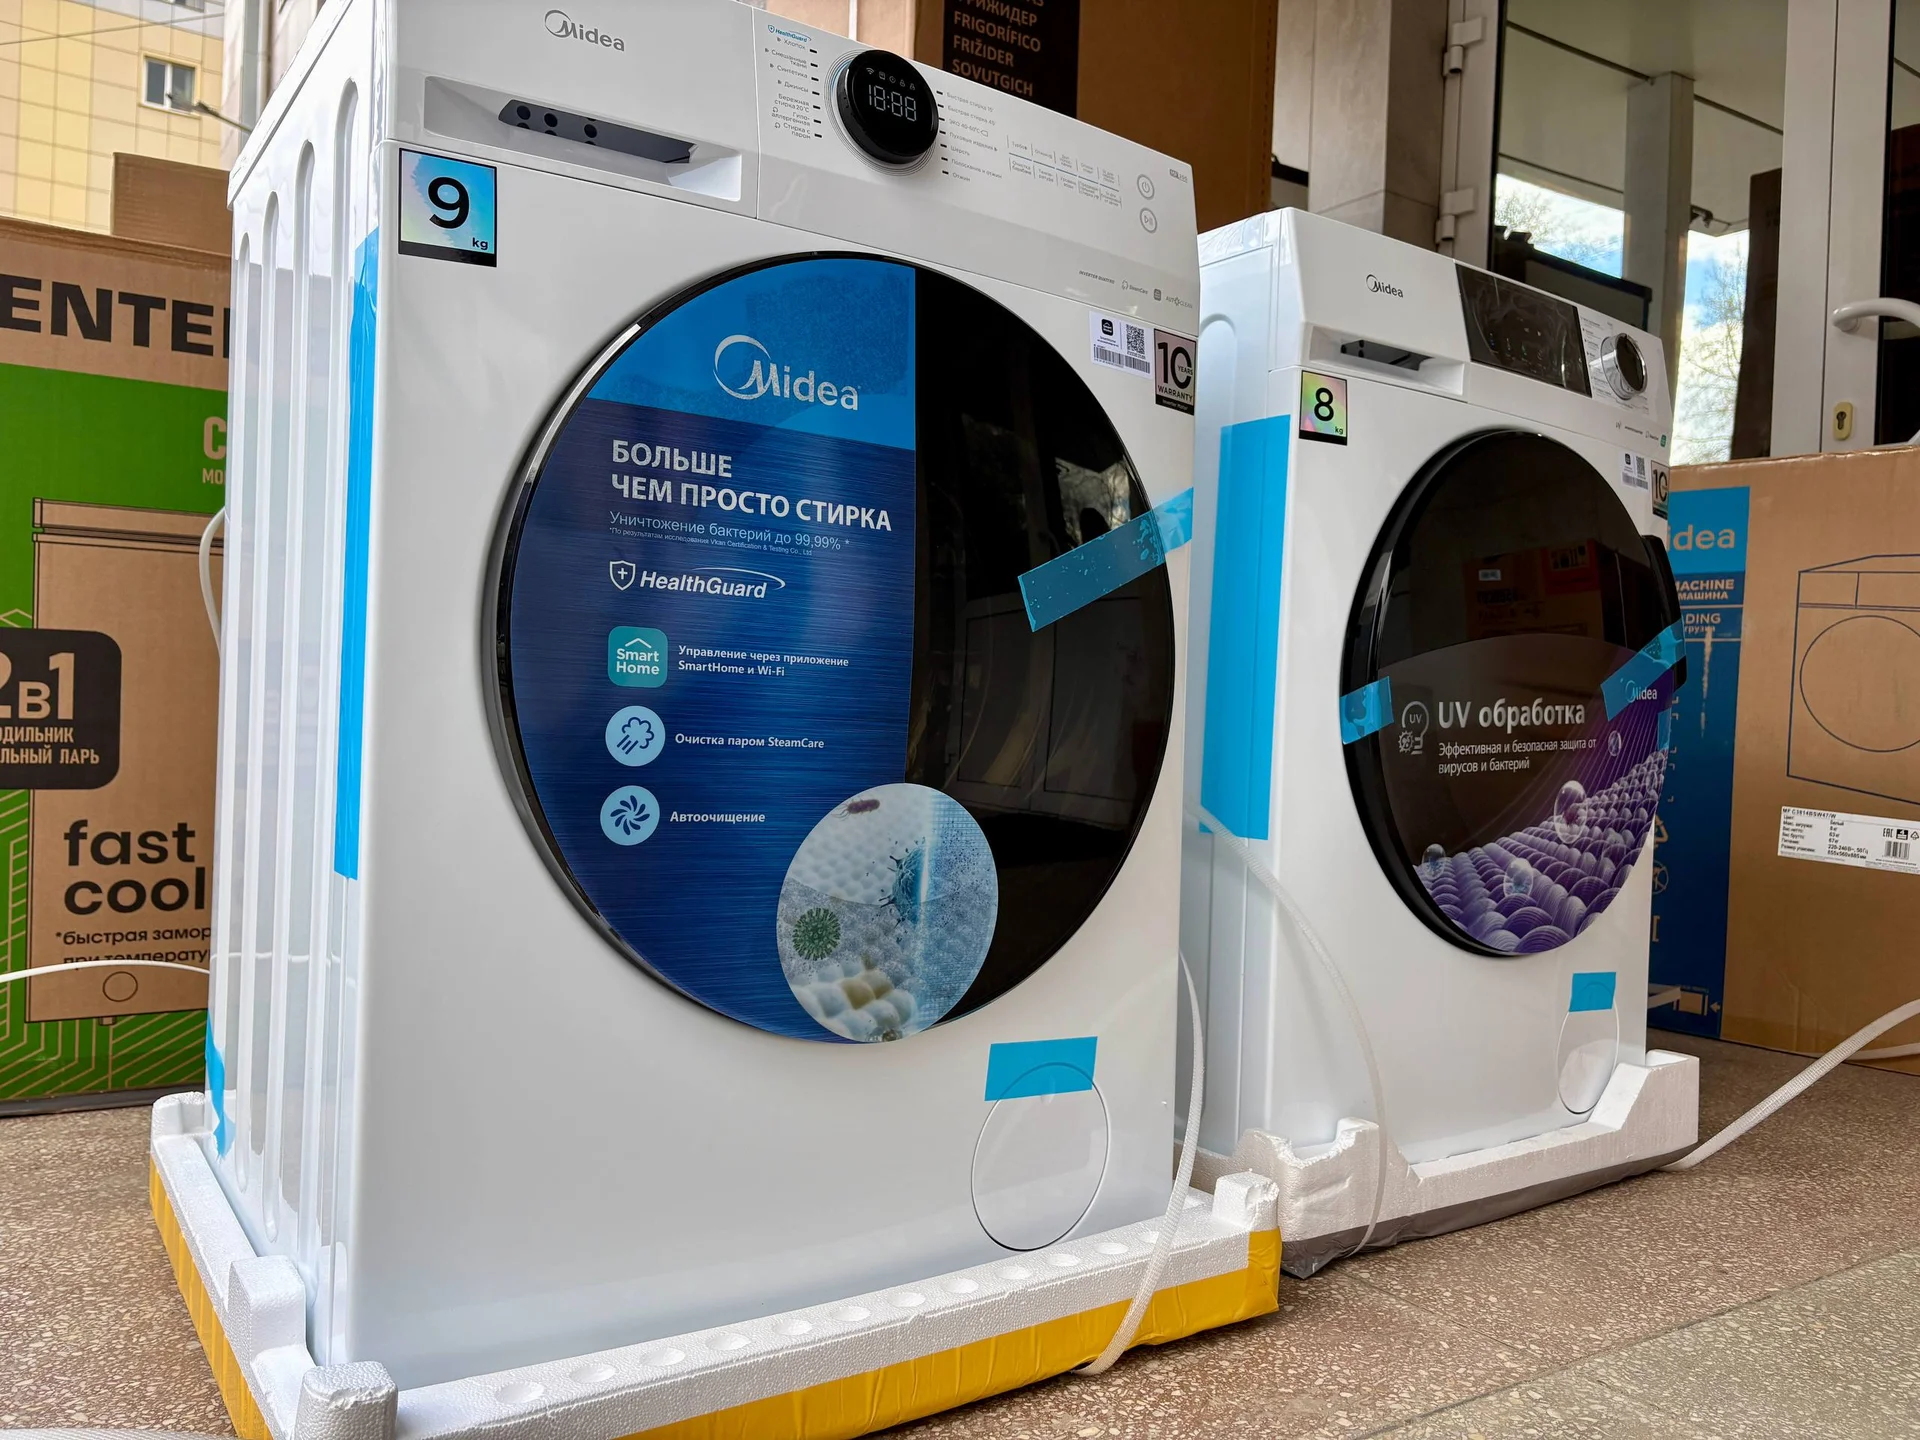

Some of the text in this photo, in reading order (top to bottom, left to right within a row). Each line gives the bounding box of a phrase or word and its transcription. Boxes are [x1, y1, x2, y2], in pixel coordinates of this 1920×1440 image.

[544, 9, 625, 52] Midea
[953, 10, 1041, 52] FRIGORÍFICO
[953, 34, 1015, 67] FRIŽIDER
[776, 64, 808, 79] Синтетика
[952, 58, 1033, 97] SOVUTGICH
[774, 99, 796, 109] стирка
[778, 93, 810, 107] Бережная
[783, 122, 806, 133] Стирка
[427, 176, 470, 229] 9
[471, 236, 489, 251] kg
[1366, 273, 1404, 298] Midea
[0, 273, 231, 359] ENTE
[712, 333, 860, 411] Midea
[1157, 341, 1192, 390] 10
[1177, 365, 1194, 377] YEARS
[1157, 384, 1193, 403] WARRANTY
[1313, 387, 1335, 422] 8
[1334, 426, 1344, 435] kg
[612, 438, 733, 478] БОЛЬШЕ
[611, 473, 892, 532] ЧЕМ ПРОСТО СТИРКА
[609, 510, 841, 551] Уничтожение бактерий до 99,99%
[622, 529, 663, 540] результатам
[664, 534, 709, 545] исследования
[727, 540, 762, 551] Certification
[769, 544, 790, 555] Testing
[640, 570, 768, 600] HealthGuard
[616, 647, 660, 664] Smart
[678, 645, 850, 668] Управление через приложение
[616, 661, 660, 676] Home
[678, 660, 786, 677] SmartHome и Wi-Fi
[1409, 713, 1422, 724] UV
[1437, 697, 1586, 734] UV обработка
[0, 726, 75, 744] ДИЛЬНИК
[675, 733, 825, 750] Очистка паром SteamCare
[60, 748, 100, 765] ЛАРЬ
[1438, 738, 1597, 760] Эффективная и безопасная защита от
[1438, 756, 1531, 777] вирусов и бактерий
[670, 810, 766, 825] Автоочищение
[63, 819, 196, 867] fast
[63, 867, 206, 915] cool
